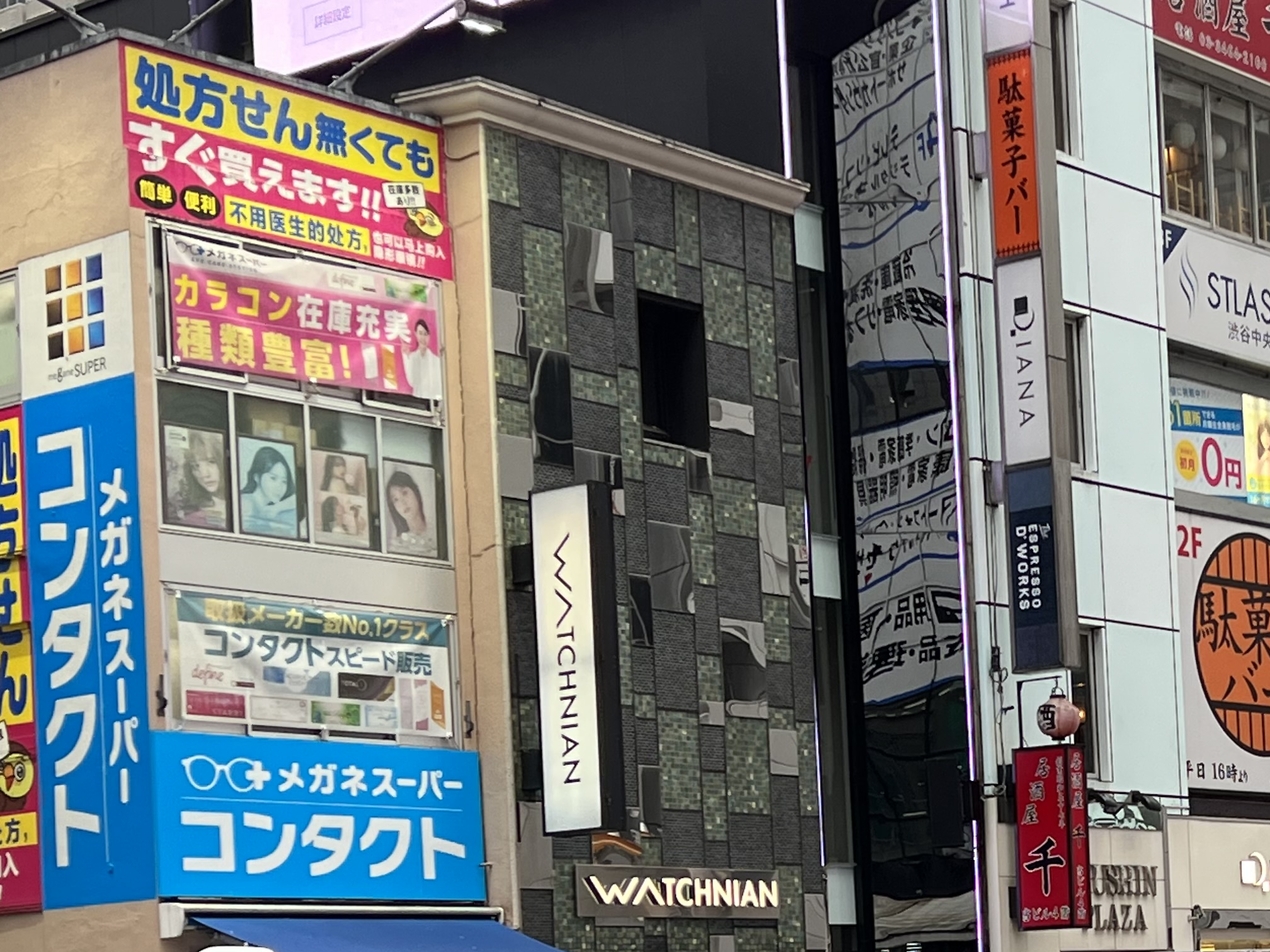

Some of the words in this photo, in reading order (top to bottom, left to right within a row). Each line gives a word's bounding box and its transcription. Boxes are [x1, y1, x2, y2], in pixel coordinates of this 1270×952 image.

[134, 55, 435, 179] 処方せん無くても
[128, 119, 382, 222] すぐ買えます!!
[997, 73, 1028, 235] 駄菓子バー
[138, 179, 173, 205] 簡単
[184, 189, 217, 216] 便利
[174, 273, 413, 344] カラコン在庫充実
[175, 316, 351, 381] 種類豊富!
[1015, 525, 1030, 610] D'WORKS
[1028, 523, 1041, 609] ESPRESSO
[1177, 524, 1202, 558] 2F
[36, 426, 101, 868] コンタクト
[99, 467, 139, 804] メガネスーパー
[553, 532, 581, 786] WATCHNIAN
[278, 762, 464, 801] メガネスーパー
[1021, 756, 1051, 826] 居酒屋
[180, 809, 466, 880] コンタクト
[1022, 835, 1067, 897] 千
[584, 876, 779, 908] WATCHNIAN
